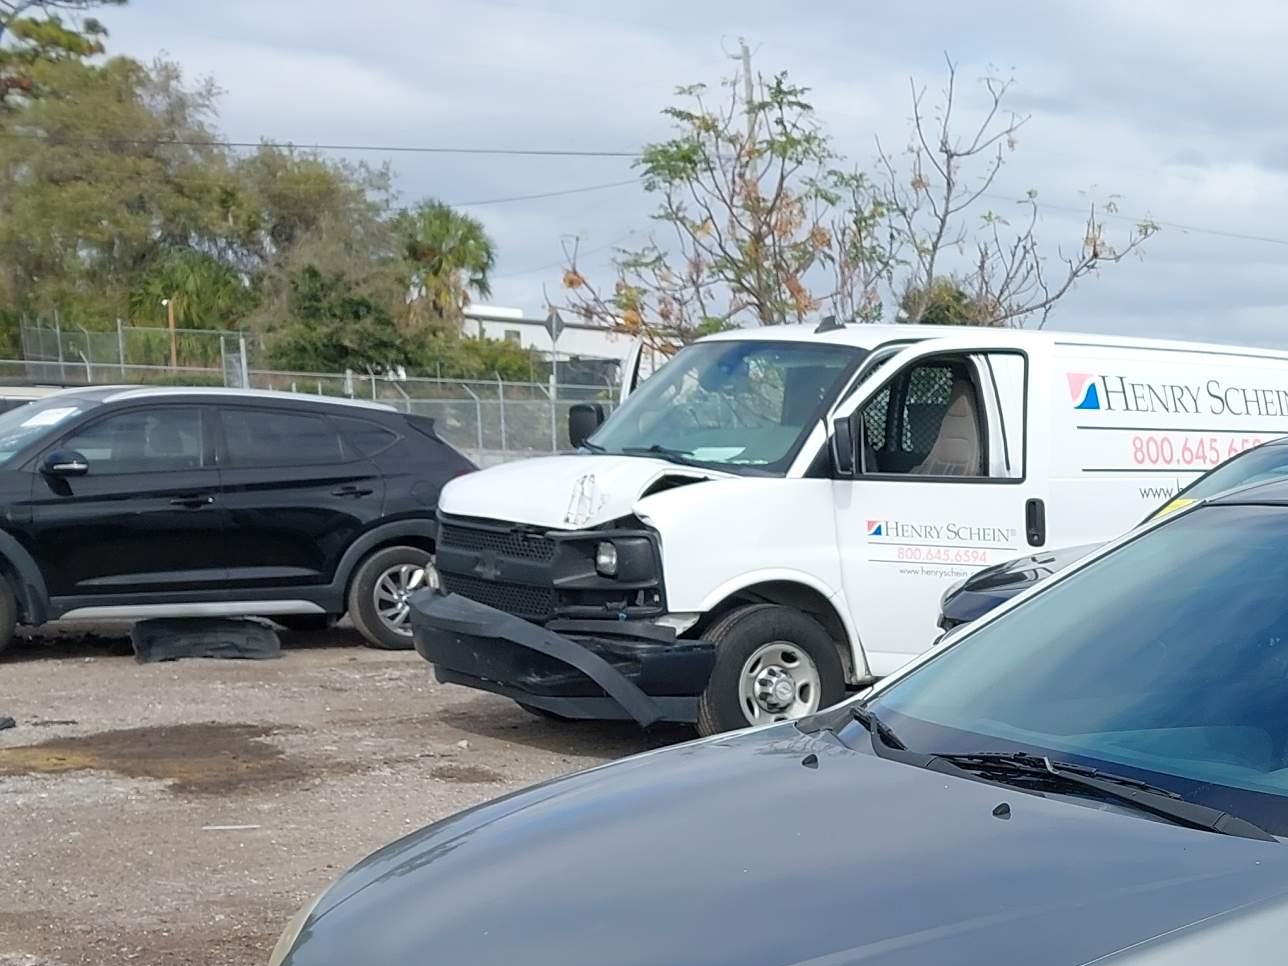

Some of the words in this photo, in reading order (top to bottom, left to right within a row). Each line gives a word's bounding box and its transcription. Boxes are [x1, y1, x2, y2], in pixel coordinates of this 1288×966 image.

[1098, 374, 1202, 414] HENRY
[884, 520, 944, 540] HENRY
[896, 547, 988, 563] 800.645.6594
